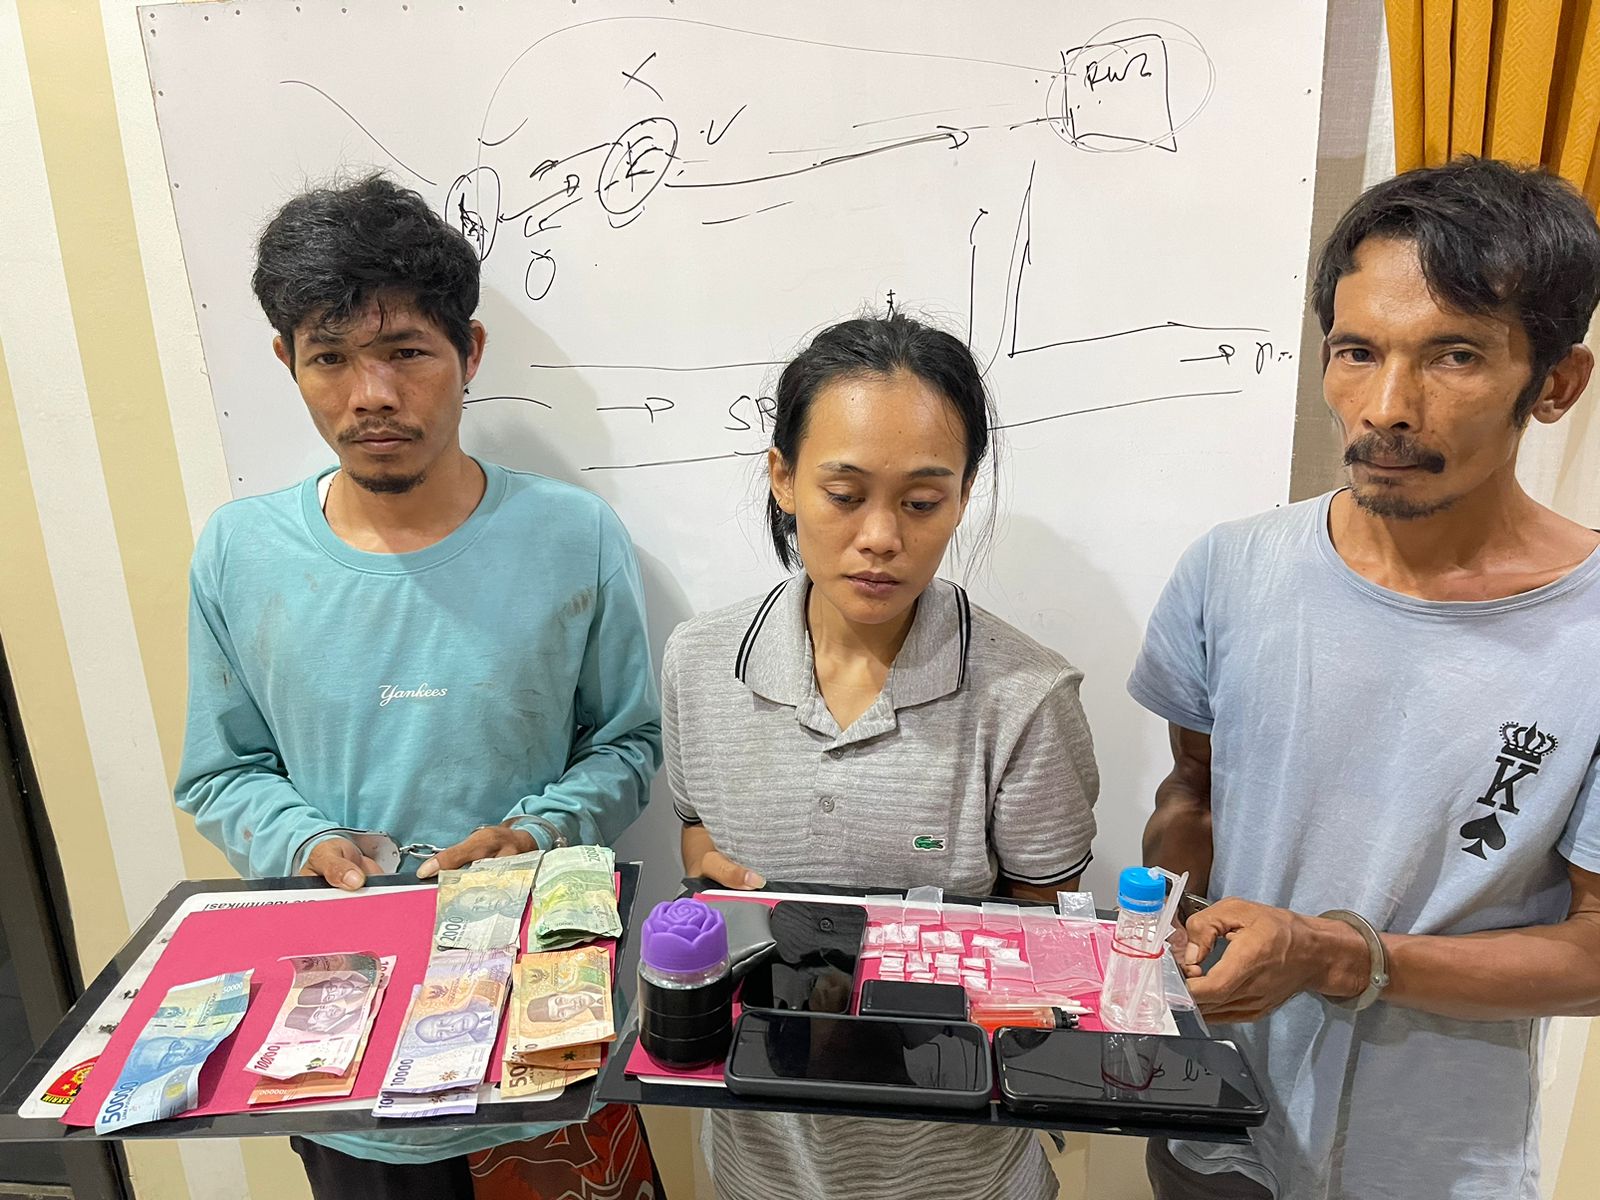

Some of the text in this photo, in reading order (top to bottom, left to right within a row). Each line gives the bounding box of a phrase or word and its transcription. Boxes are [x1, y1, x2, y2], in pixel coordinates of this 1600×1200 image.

[378, 682, 448, 707] Yankees
[1476, 755, 1540, 816] K
[439, 916, 464, 942] 2000
[390, 1058, 414, 1087] 10000
[101, 1081, 139, 1124] 50000
